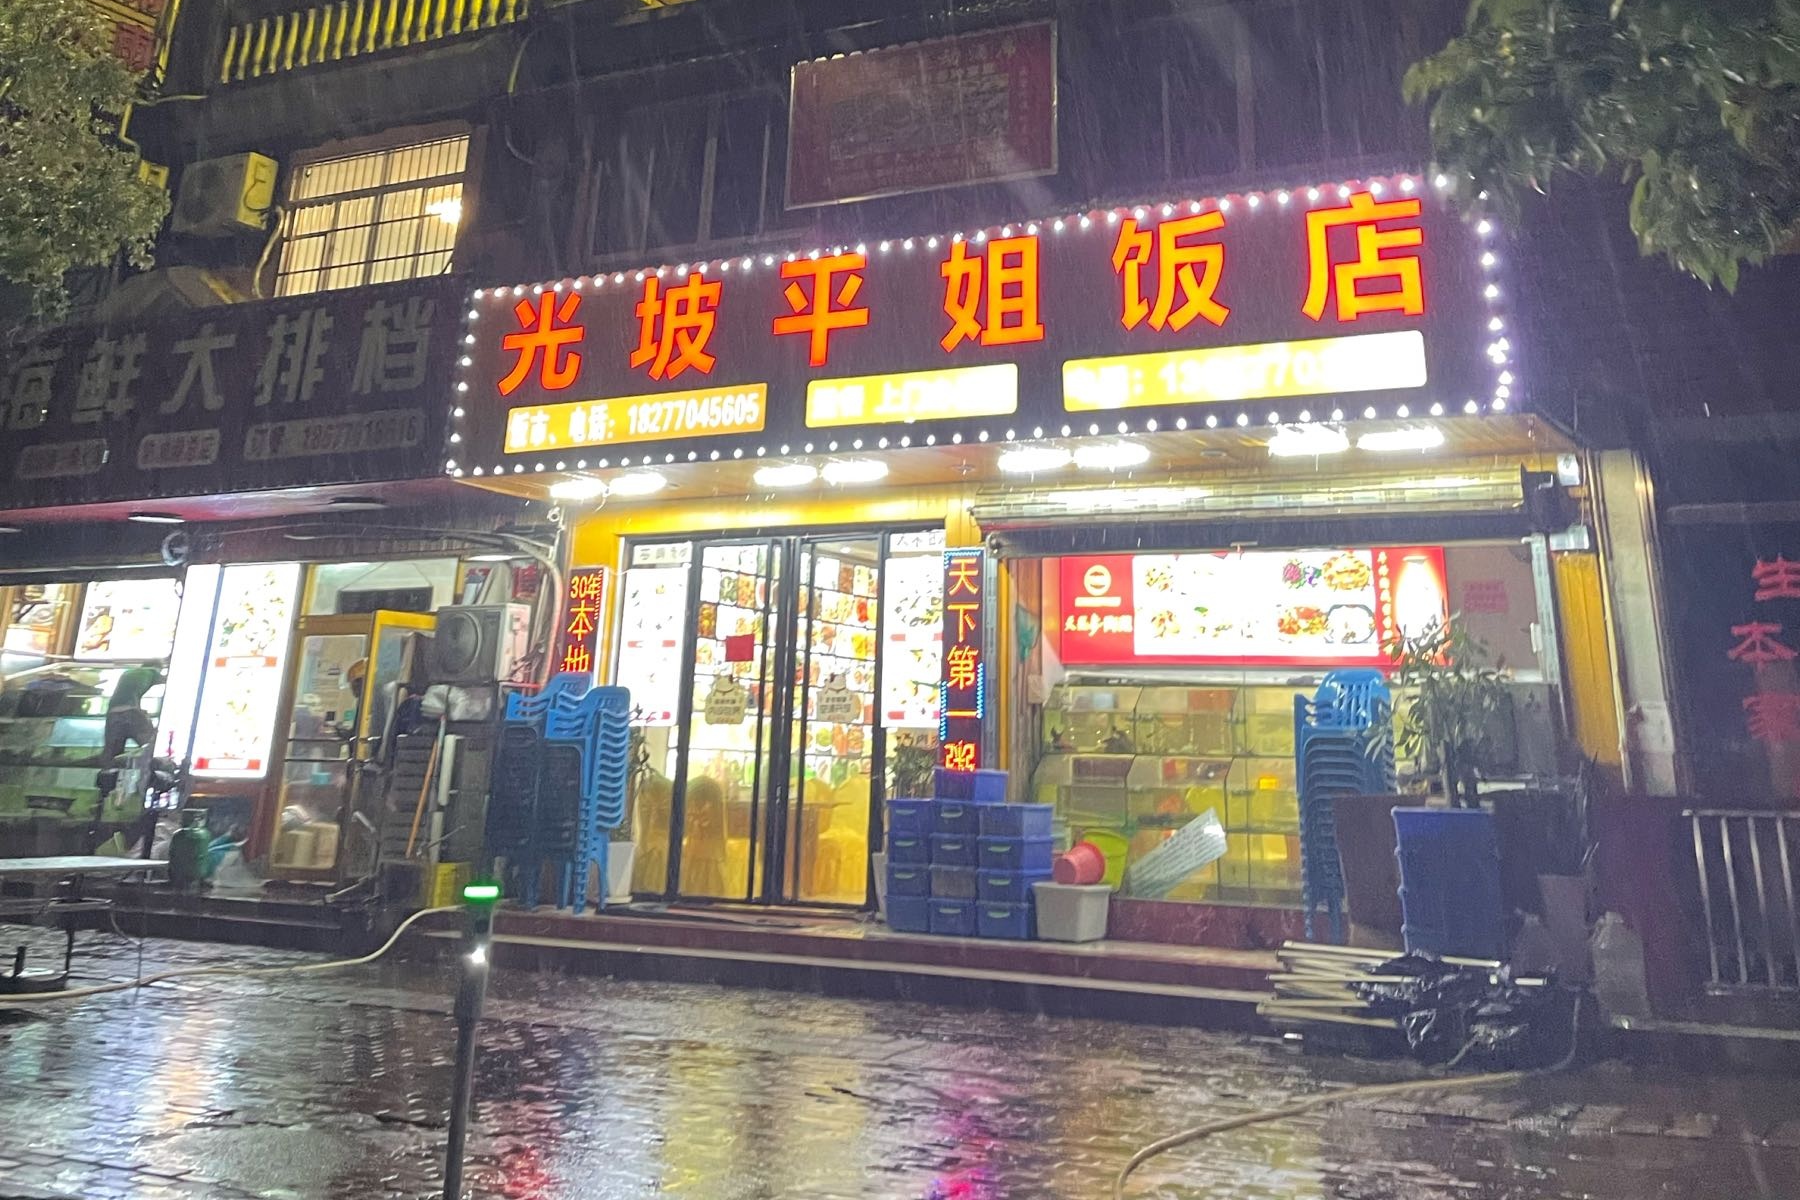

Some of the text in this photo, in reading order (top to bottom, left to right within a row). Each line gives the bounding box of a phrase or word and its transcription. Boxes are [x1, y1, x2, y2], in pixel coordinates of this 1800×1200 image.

[498, 191, 1425, 397] 光坡平姐饭店
[944, 557, 980, 773] 天下第一粥
